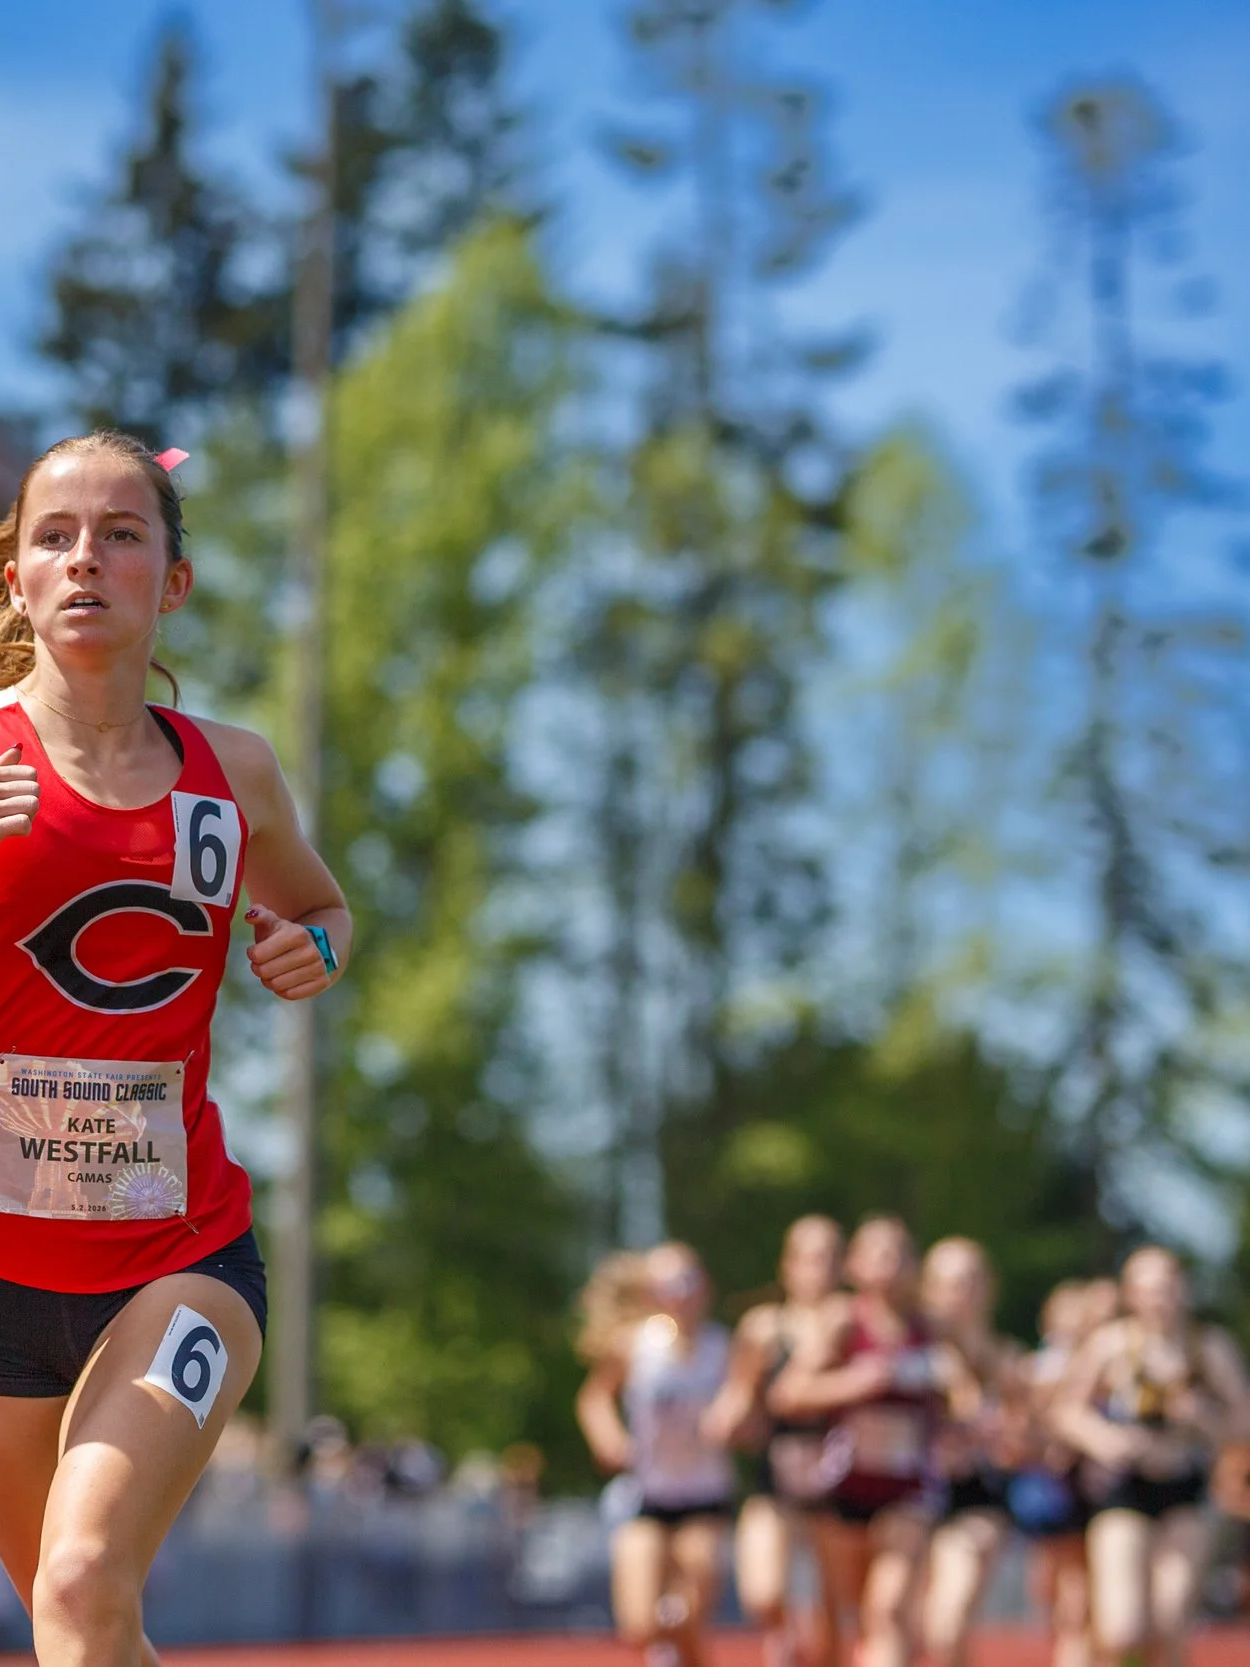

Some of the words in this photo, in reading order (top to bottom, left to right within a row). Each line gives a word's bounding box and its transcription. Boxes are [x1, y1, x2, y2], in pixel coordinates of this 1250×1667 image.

[189, 800, 227, 897] 6
[14, 879, 213, 1014] C
[21, 1068, 74, 1078] WASHINGTON
[105, 1072, 124, 1080] FAIR
[12, 1077, 57, 1099] SOUTH
[63, 1081, 111, 1101] SOUND
[115, 1082, 167, 1101] CLASSIC
[68, 1117, 116, 1134] KATE
[19, 1137, 161, 1164] WESTFALL
[67, 1172, 112, 1184] CAMAS
[171, 1325, 221, 1403] 6
